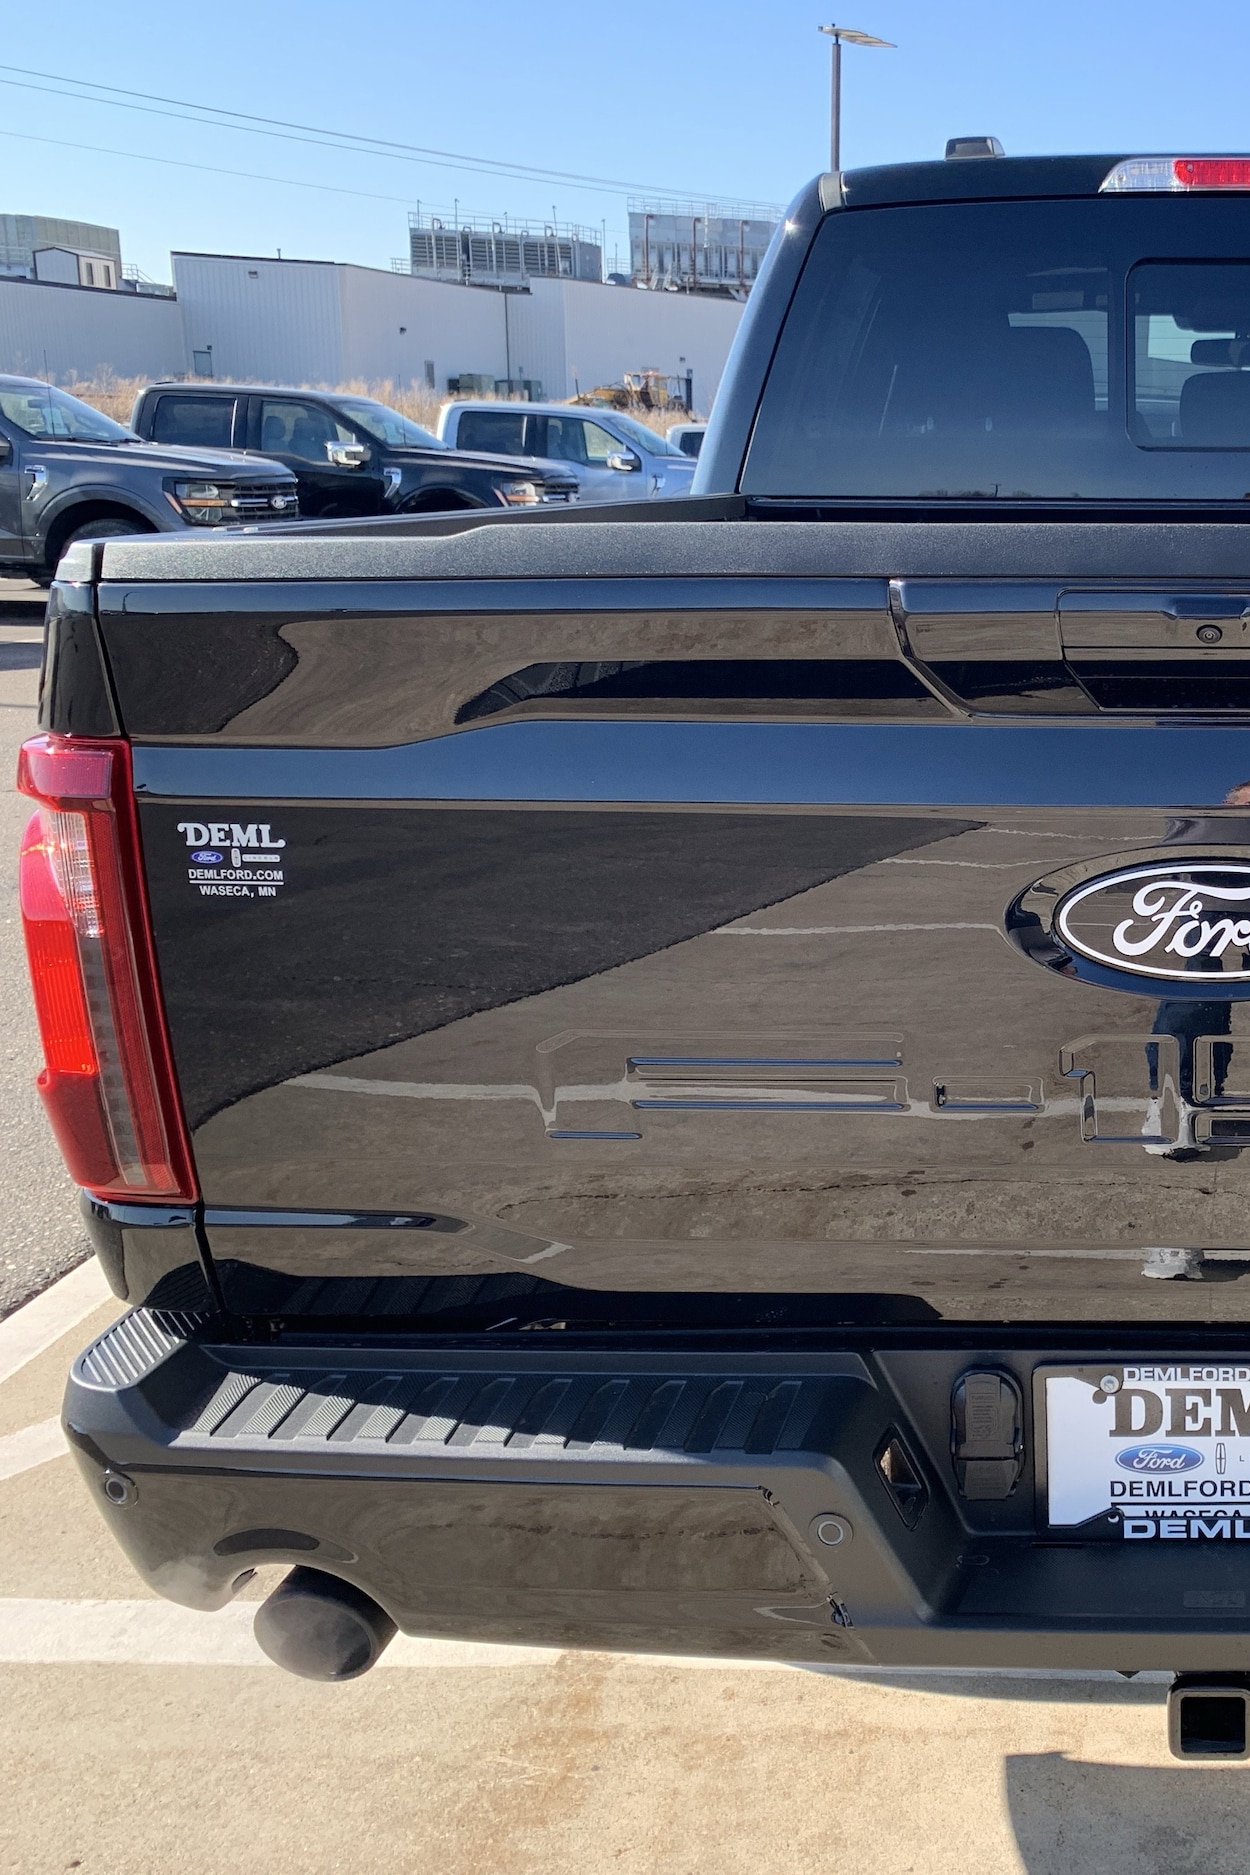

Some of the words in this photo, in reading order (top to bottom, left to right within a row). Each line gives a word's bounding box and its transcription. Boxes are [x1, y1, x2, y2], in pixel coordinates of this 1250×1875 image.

[177, 822, 286, 848] DEML
[188, 869, 283, 880] DEMLFORD.COM
[199, 885, 254, 898] WASECA,
[258, 886, 276, 897] MN
